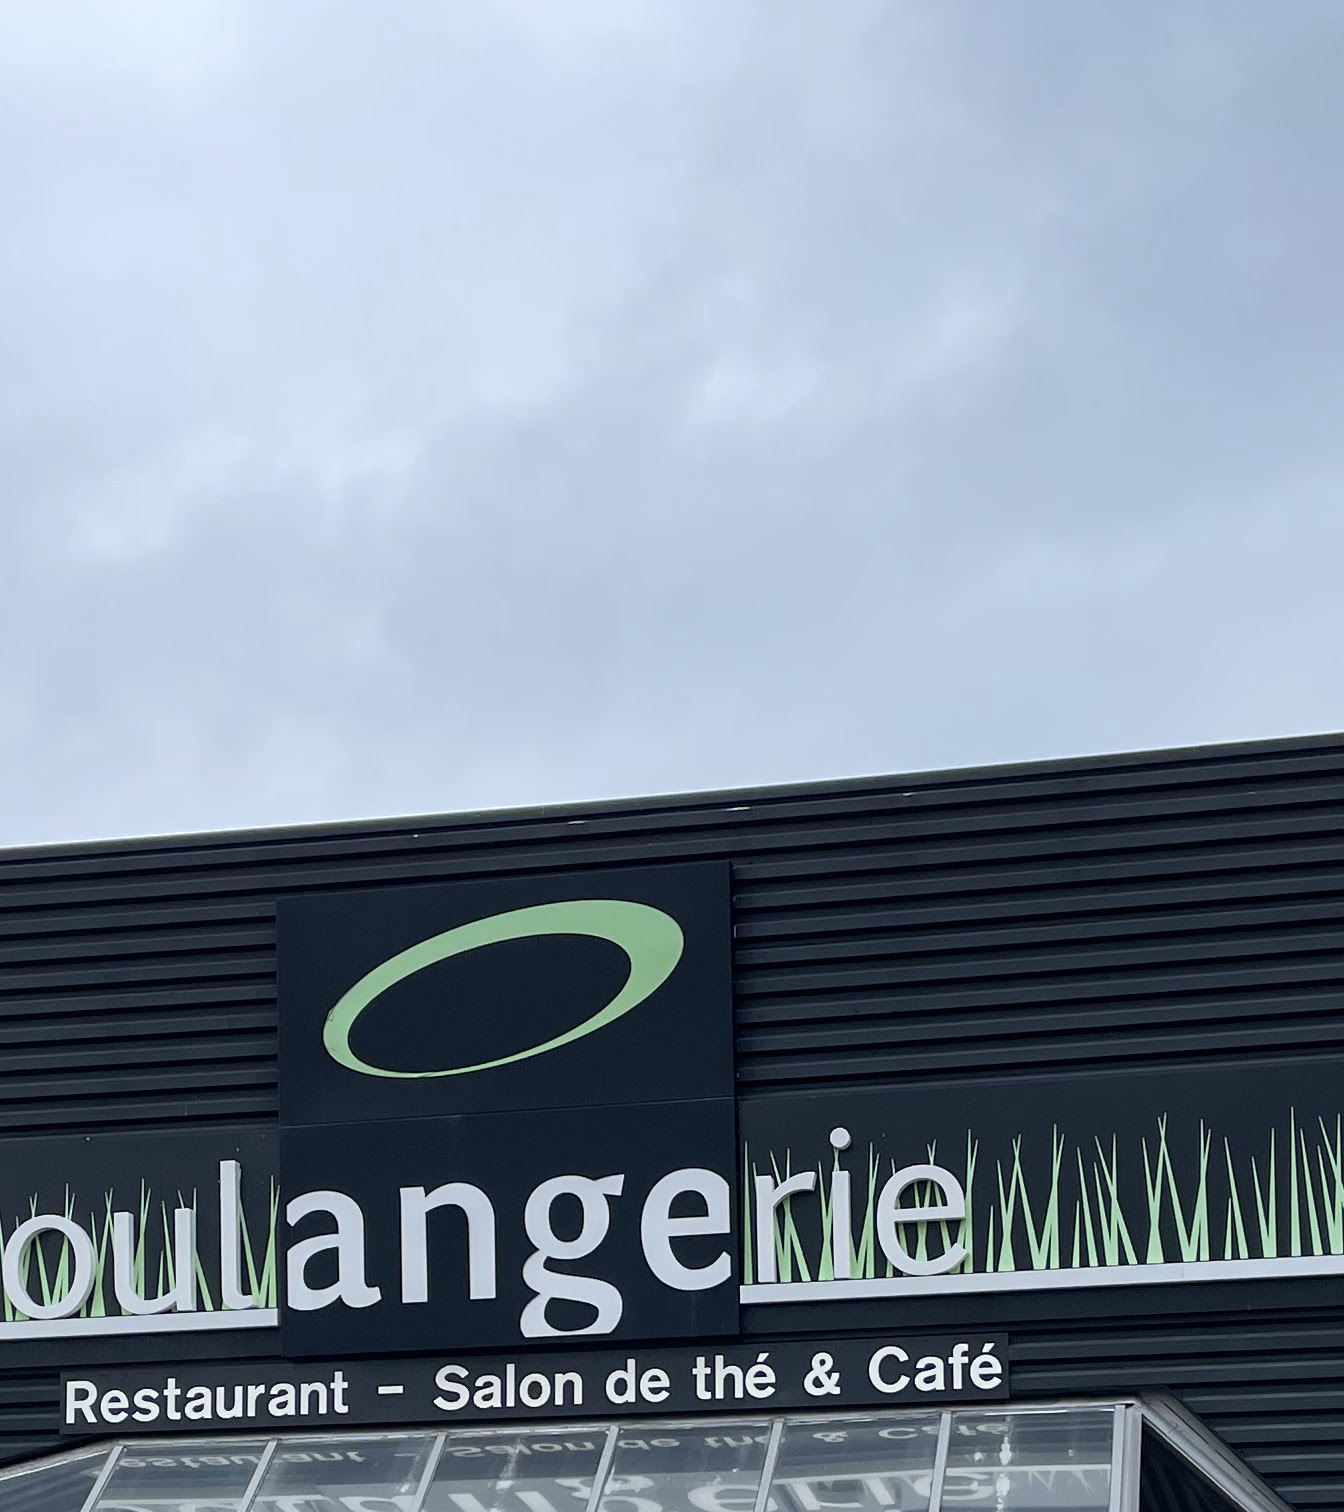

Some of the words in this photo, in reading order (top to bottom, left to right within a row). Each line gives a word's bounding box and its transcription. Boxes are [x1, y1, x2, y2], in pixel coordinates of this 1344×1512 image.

[65, 1371, 349, 1424] Restaurant
[433, 1363, 583, 1411] Salon
[605, 1358, 670, 1404] de
[691, 1352, 776, 1400] thé
[803, 1352, 841, 1396] &
[868, 1342, 1002, 1393] Café
